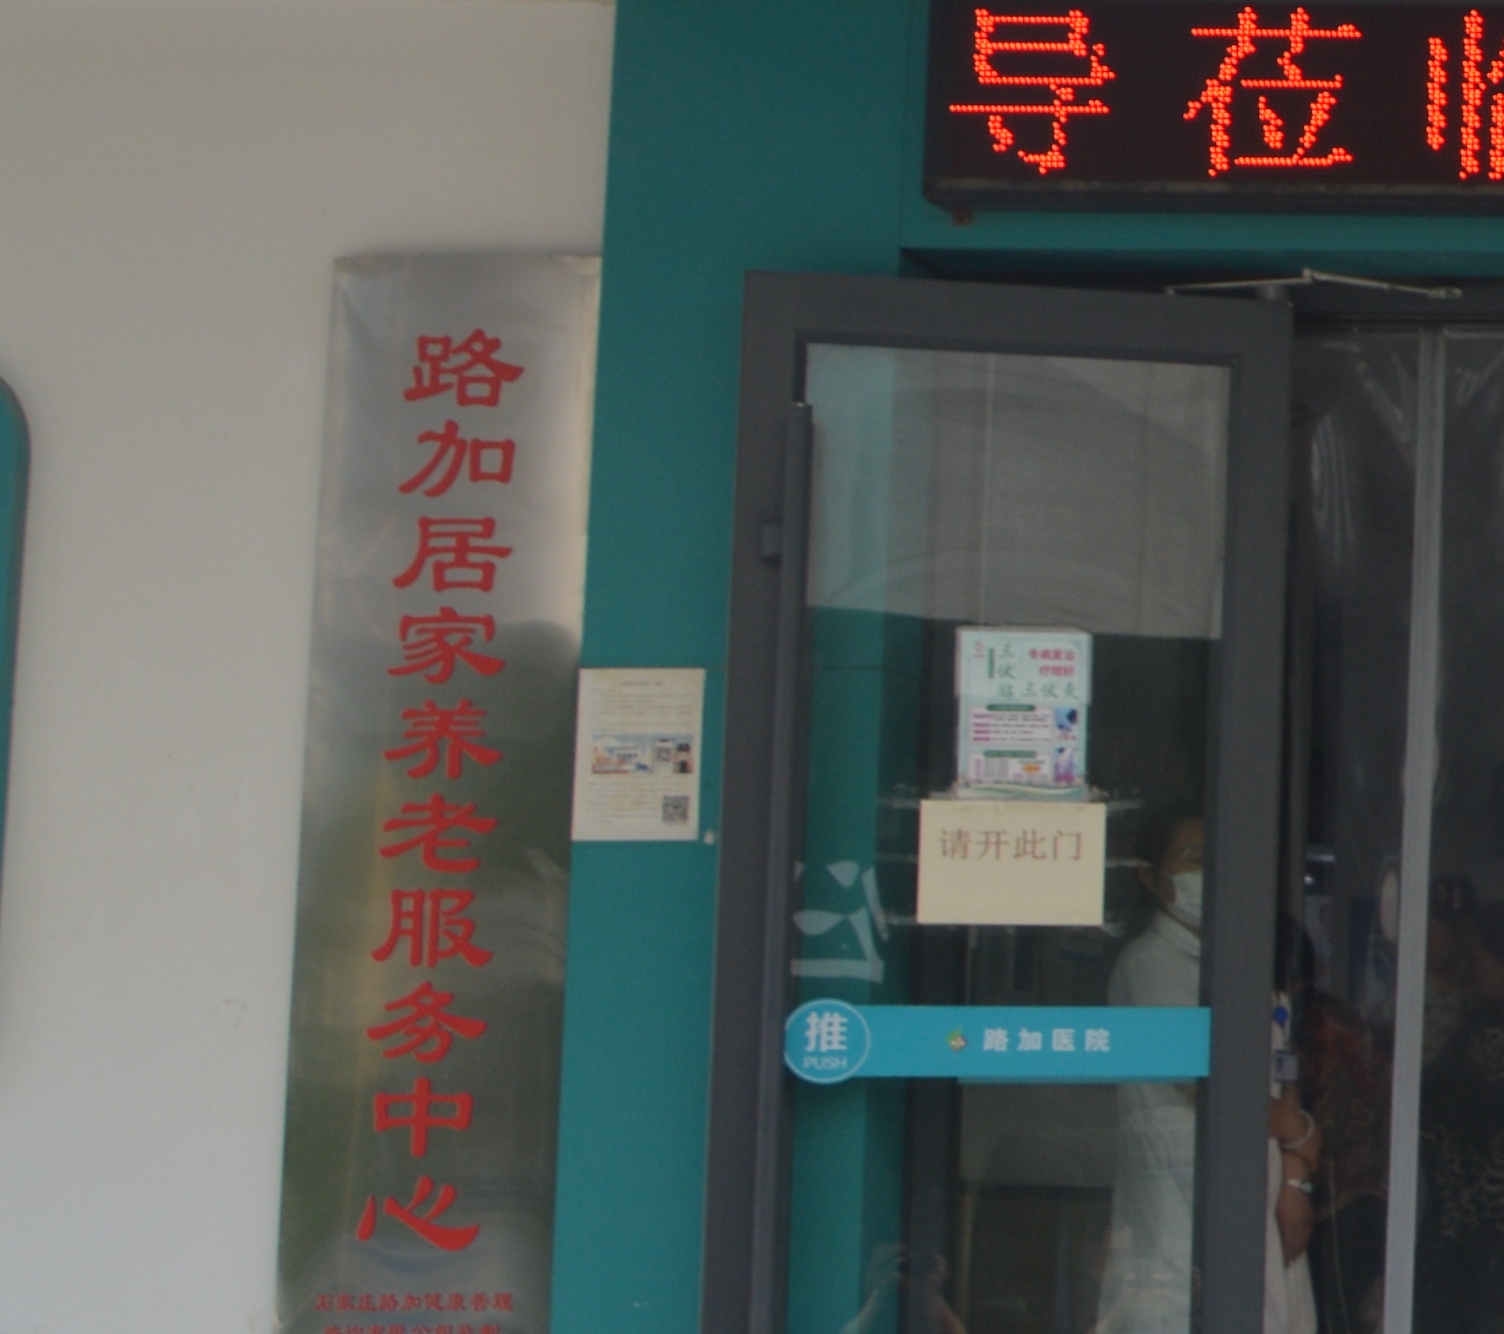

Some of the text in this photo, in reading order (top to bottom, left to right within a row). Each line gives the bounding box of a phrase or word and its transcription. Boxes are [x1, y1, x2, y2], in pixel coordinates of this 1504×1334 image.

[357, 326, 525, 1254] 路加居家养老服务中心
[938, 828, 1083, 862] 请开此门
[804, 1011, 849, 1053] 推
[982, 1028, 1112, 1052] 路加医院
[803, 1057, 848, 1070] PUSH
